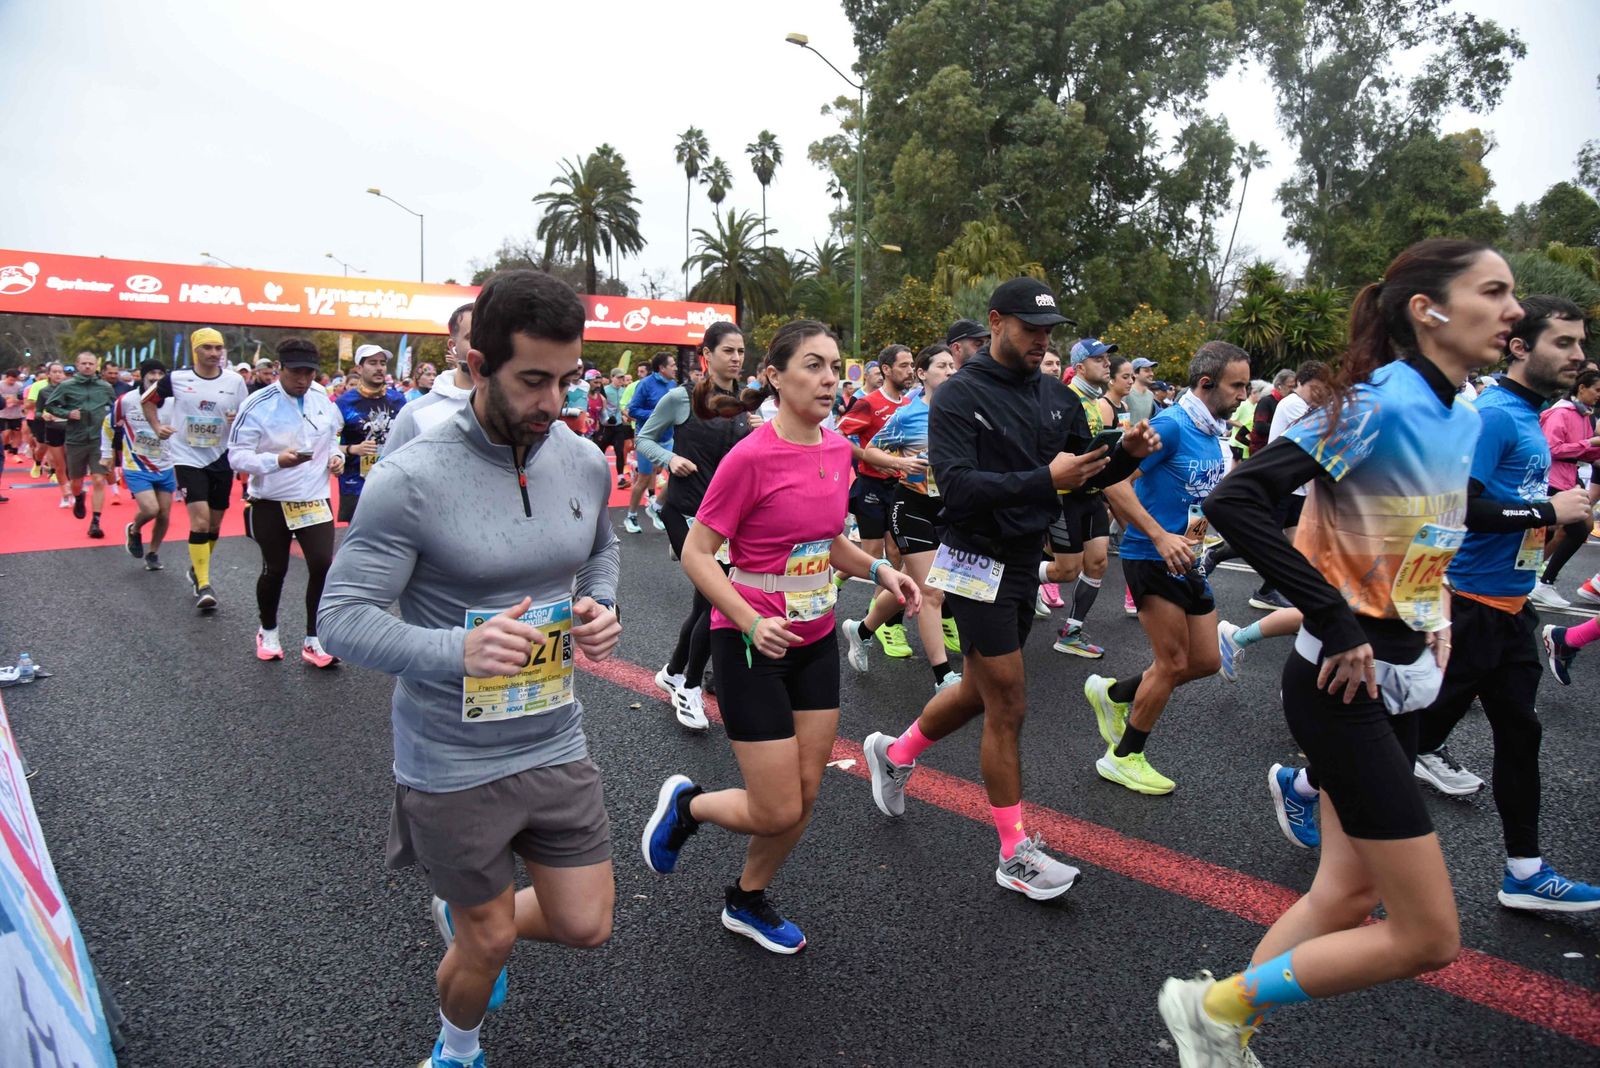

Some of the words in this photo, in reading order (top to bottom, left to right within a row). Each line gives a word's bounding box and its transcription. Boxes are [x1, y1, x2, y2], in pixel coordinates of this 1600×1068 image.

[179, 283, 244, 305] HOKA
[188, 423, 217, 434] 19642
[521, 630, 561, 668] 27
